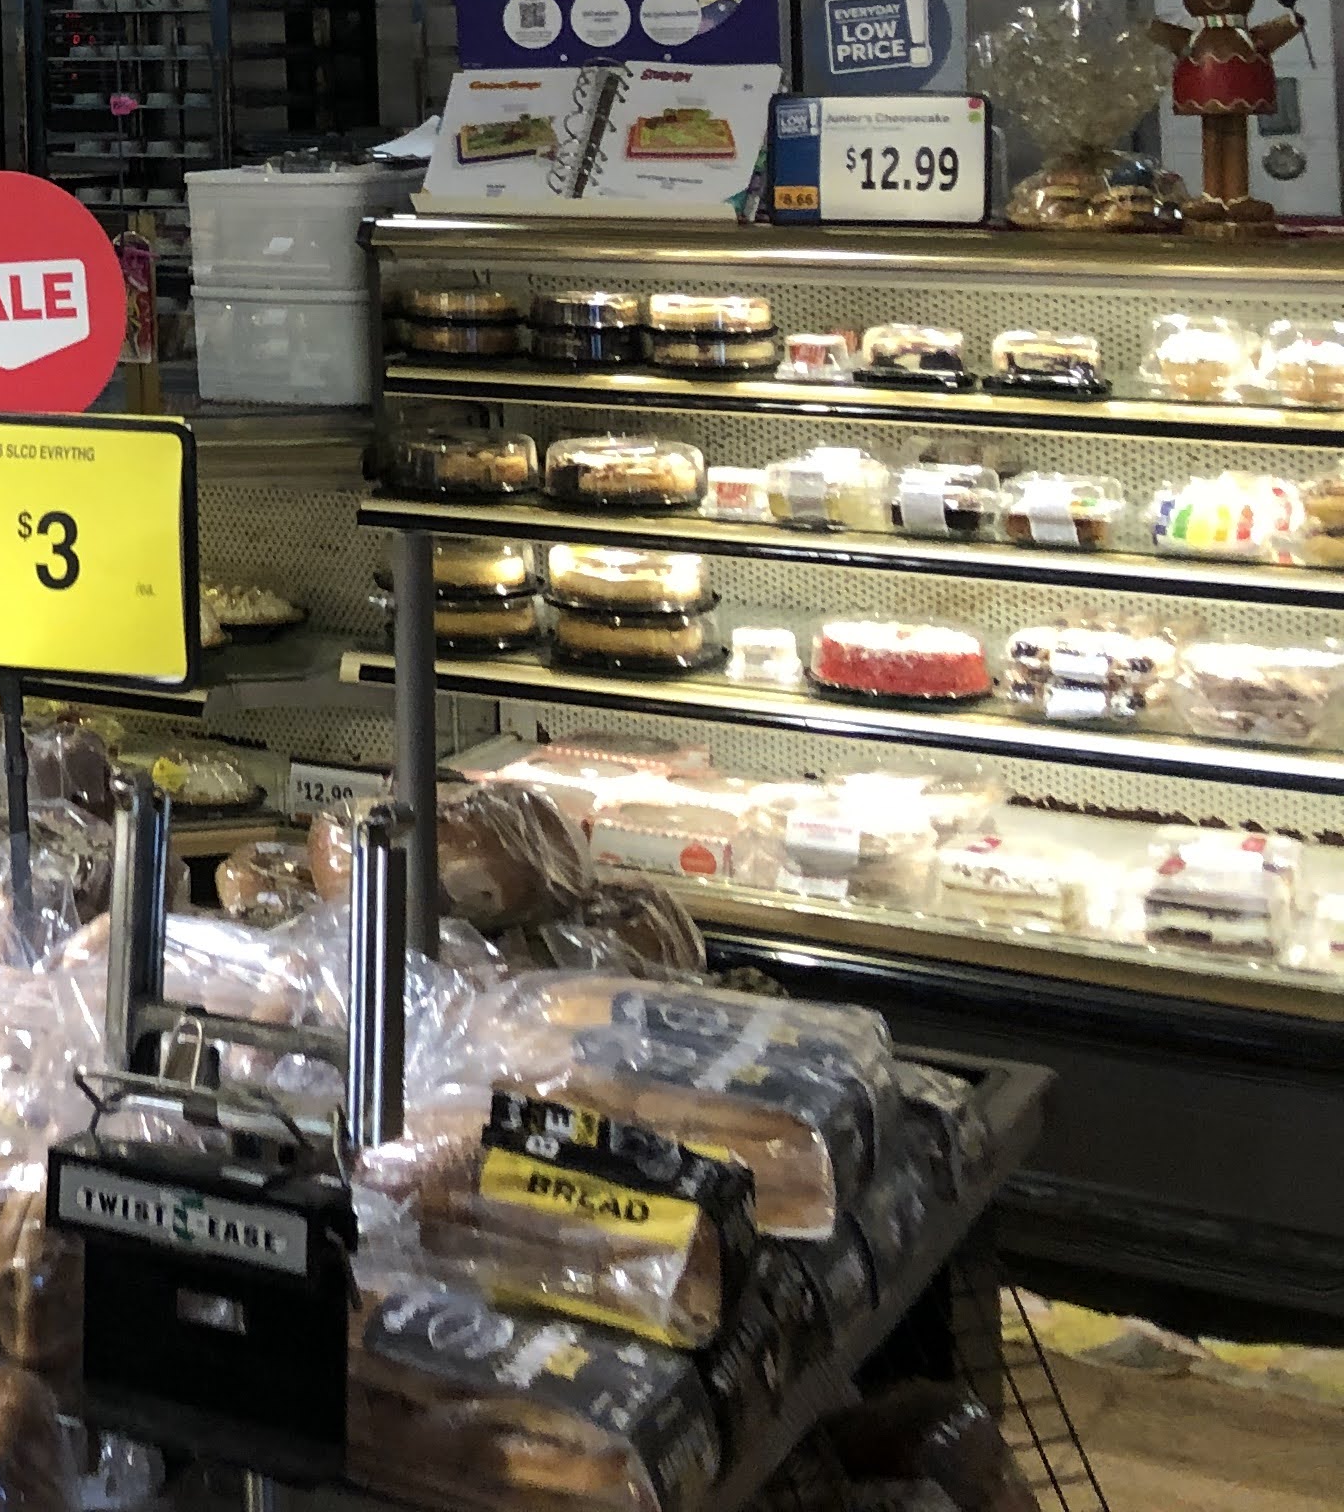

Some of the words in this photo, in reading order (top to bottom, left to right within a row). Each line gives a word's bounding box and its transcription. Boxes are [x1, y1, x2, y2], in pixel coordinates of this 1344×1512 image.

[834, 4, 901, 20] EVERYDAY
[842, 21, 897, 42] LOW
[836, 39, 907, 63] PRICE
[875, 113, 950, 123] Cheesecake
[845, 145, 960, 192] $12.99
[6, 444, 37, 459] SLCD
[40, 445, 95, 462] EVRYTHG
[18, 509, 80, 590] $3
